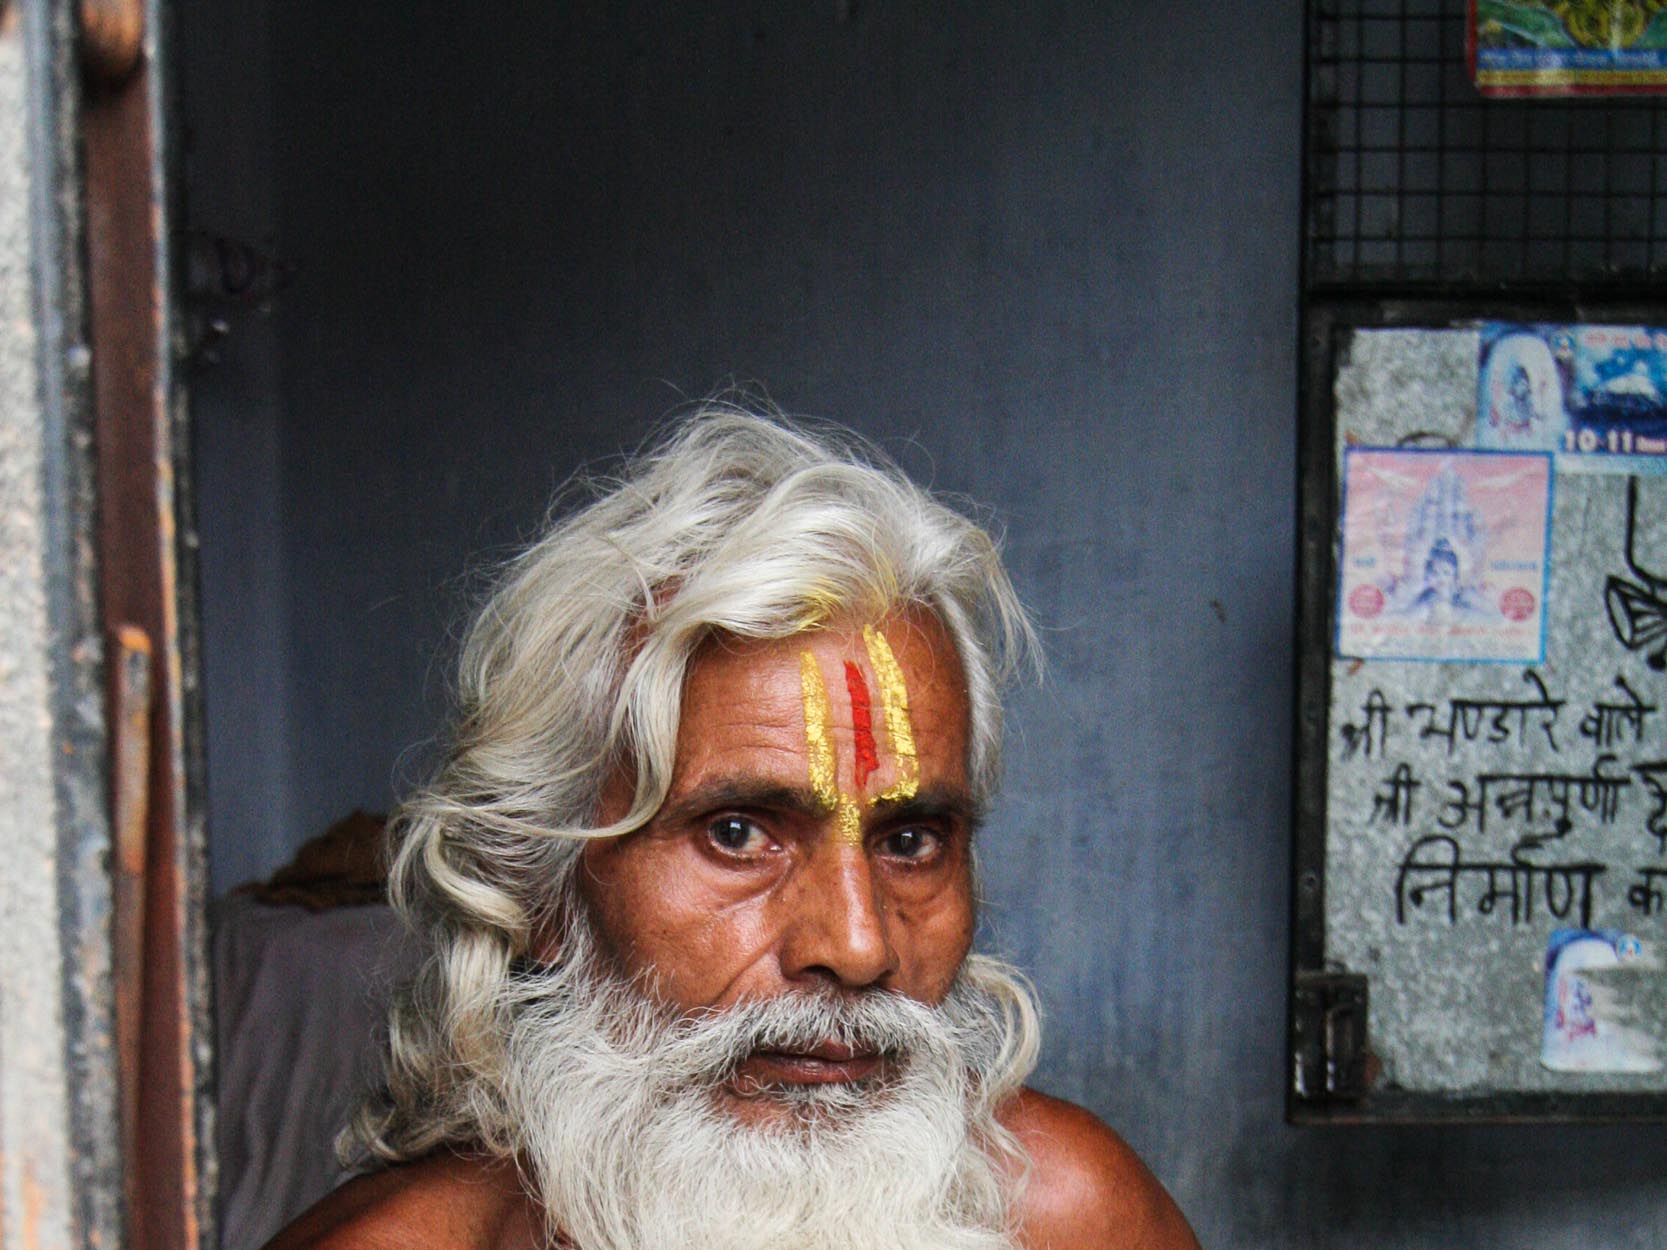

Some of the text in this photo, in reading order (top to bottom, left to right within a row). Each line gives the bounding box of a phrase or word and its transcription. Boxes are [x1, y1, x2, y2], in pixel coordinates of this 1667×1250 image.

[1340, 688, 1393, 761] श्री
[1579, 674, 1658, 746] वाले
[1368, 762, 1421, 826] श्री
[1396, 833, 1608, 928] निर्माण
